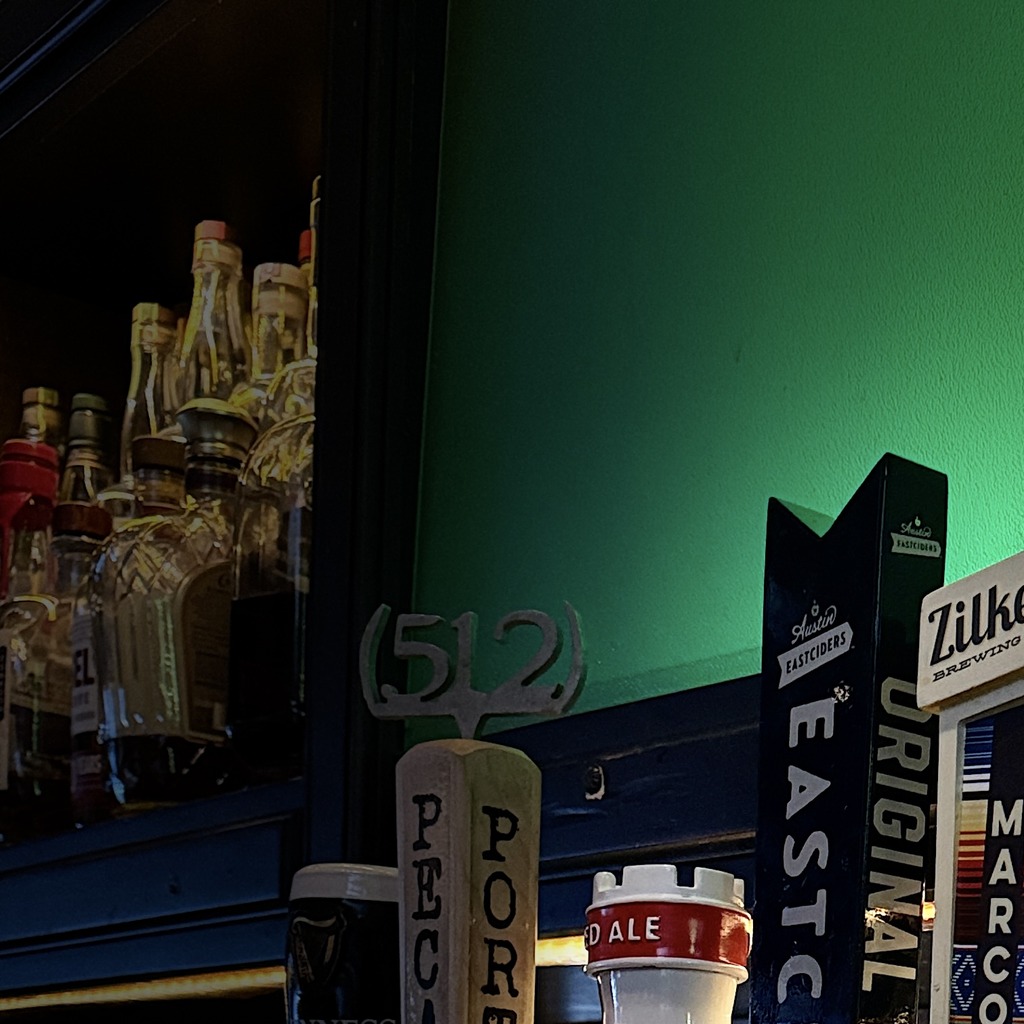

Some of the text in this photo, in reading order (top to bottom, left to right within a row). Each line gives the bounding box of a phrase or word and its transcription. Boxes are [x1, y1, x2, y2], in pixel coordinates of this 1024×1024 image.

[791, 605, 837, 645] Austin
[358, 602, 588, 718] (512)
[786, 631, 846, 674] EASTCIDERS
[932, 636, 1021, 682] BREWING
[608, 915, 661, 944] ALE
